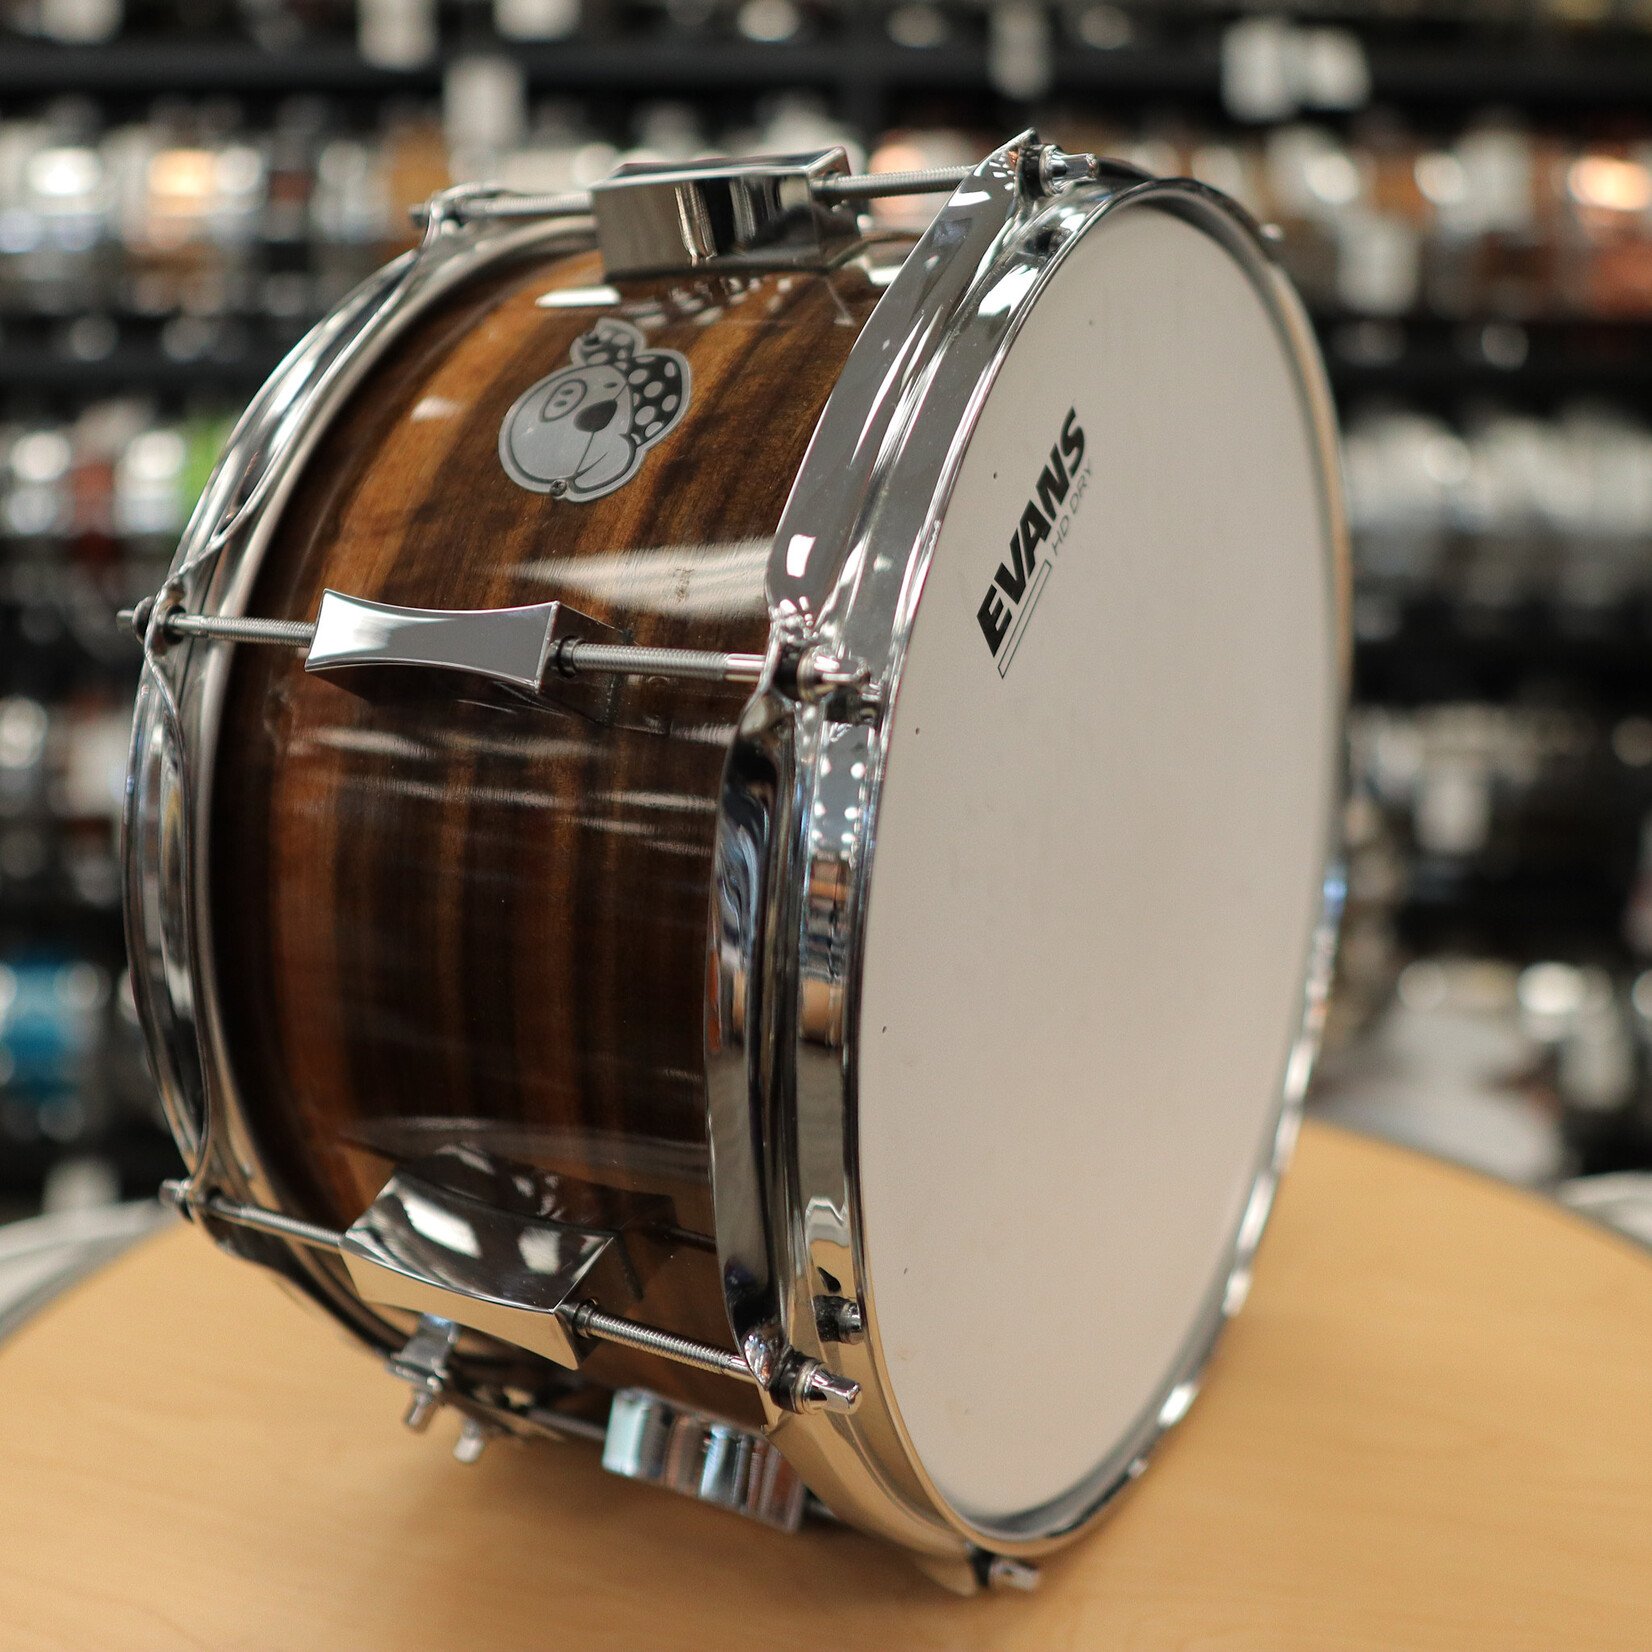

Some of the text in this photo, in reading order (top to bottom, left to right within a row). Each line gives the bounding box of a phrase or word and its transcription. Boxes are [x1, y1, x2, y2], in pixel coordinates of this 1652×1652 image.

[976, 406, 1085, 658] EVANS
[1052, 460, 1092, 556] HD DRY
